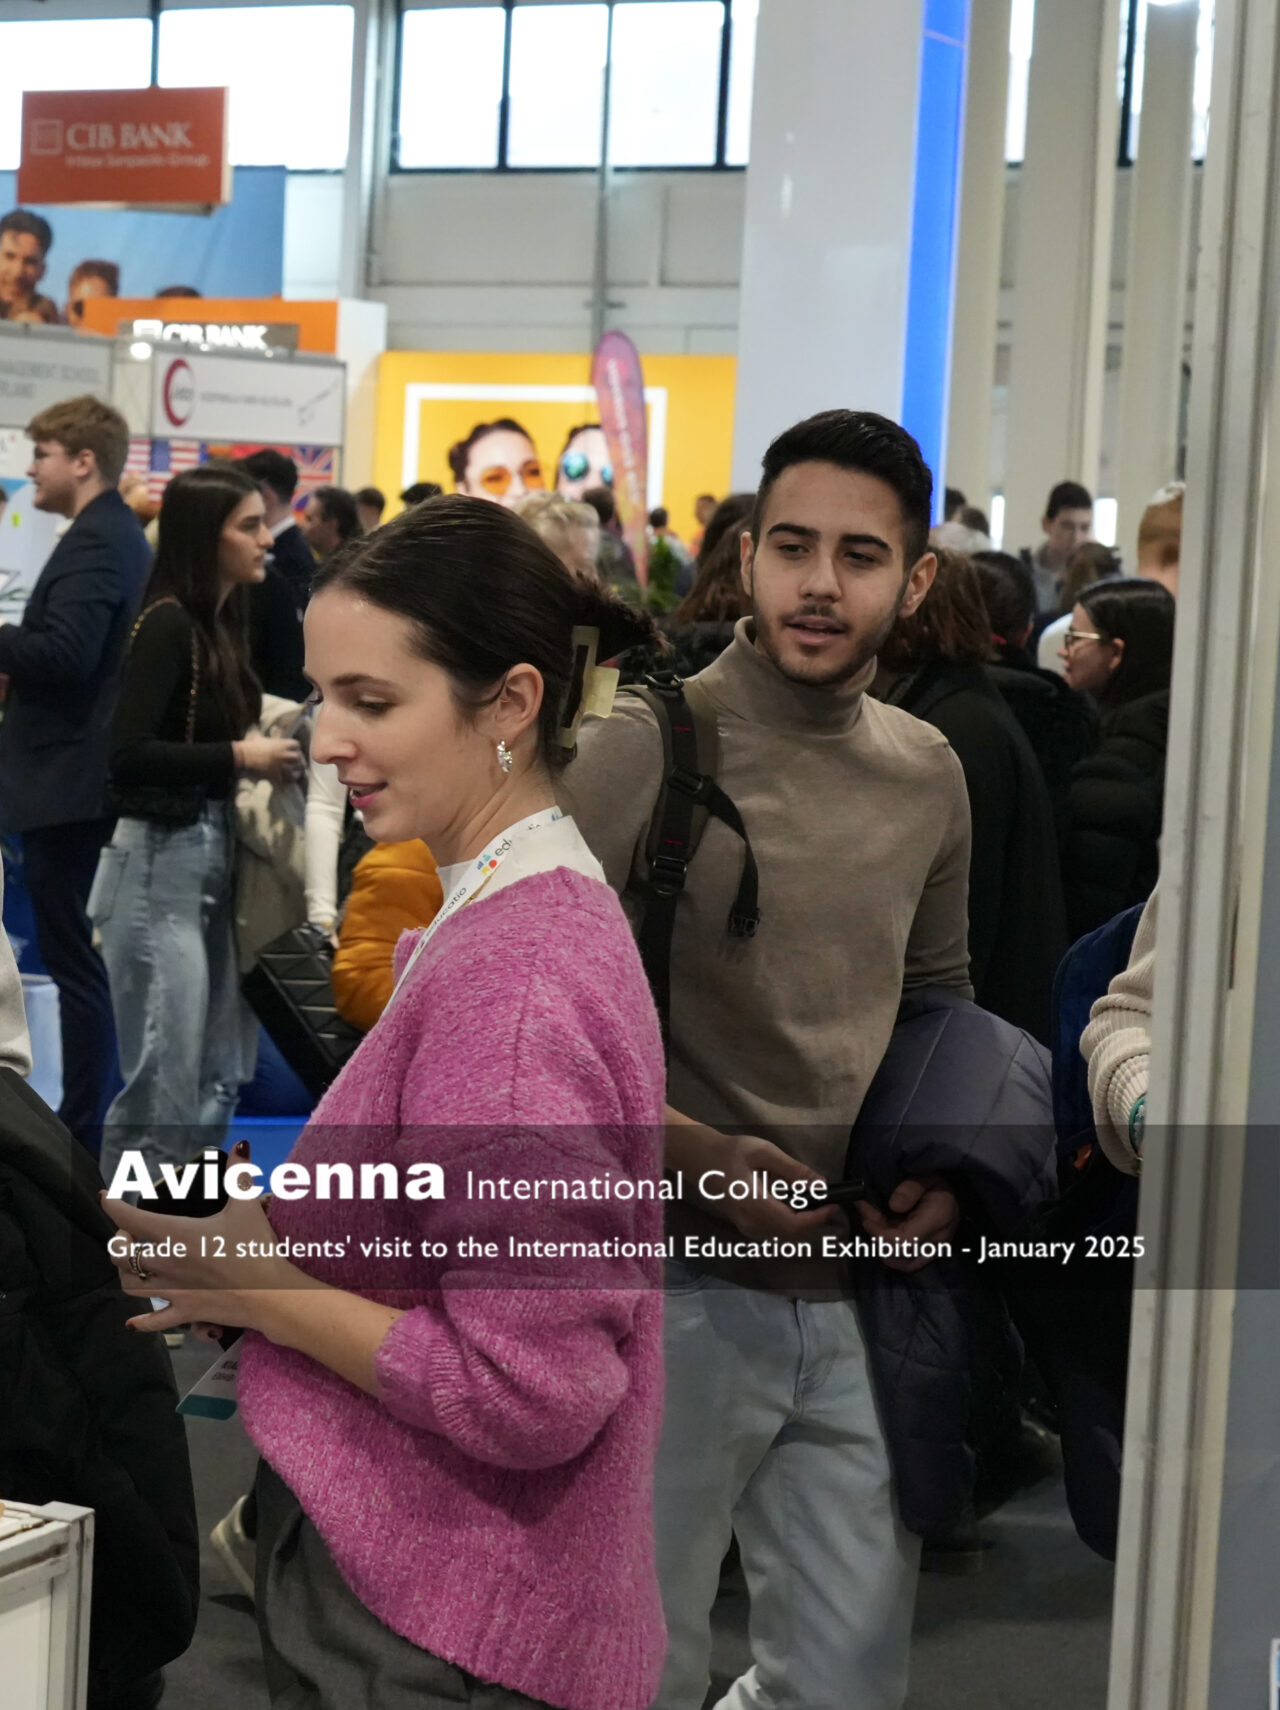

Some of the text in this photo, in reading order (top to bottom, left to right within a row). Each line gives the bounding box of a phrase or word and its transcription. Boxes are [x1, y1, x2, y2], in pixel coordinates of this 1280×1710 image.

[66, 120, 194, 151] CIB BANK
[162, 323, 269, 350] CIB BANK
